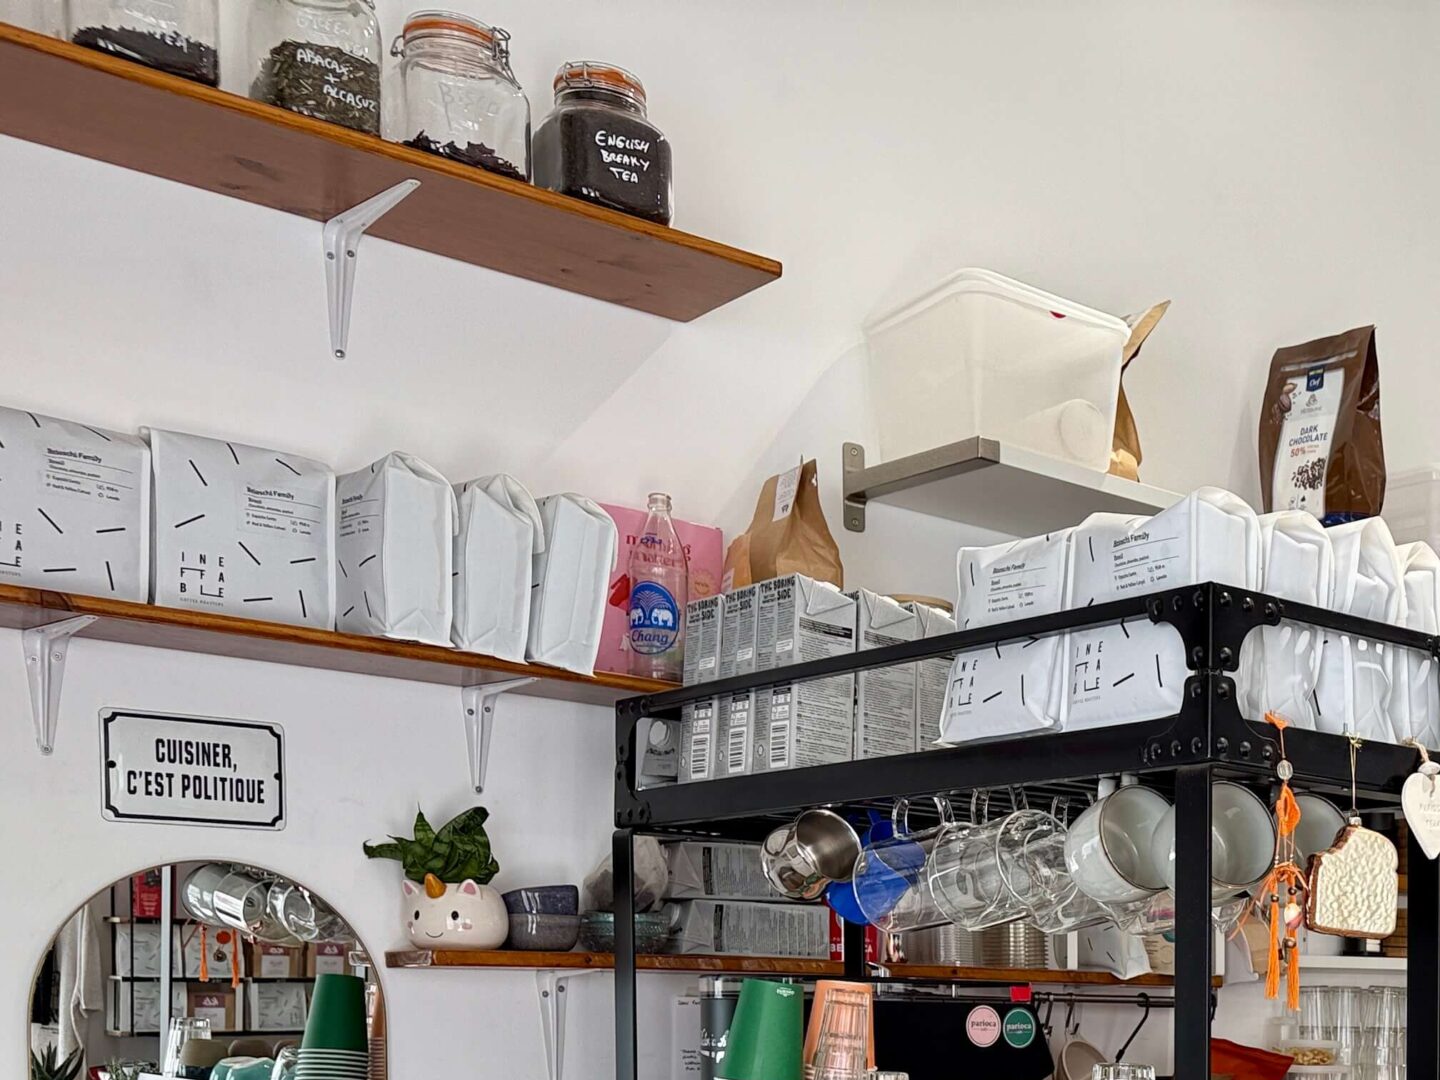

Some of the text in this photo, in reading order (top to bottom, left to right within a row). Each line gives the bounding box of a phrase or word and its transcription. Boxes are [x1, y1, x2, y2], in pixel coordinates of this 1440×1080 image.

[595, 130, 651, 154] ENGLISH
[609, 166, 640, 185] TEA
[1300, 424, 1319, 437] DARK
[1289, 432, 1328, 448] CHOCOLATE
[1290, 447, 1306, 458] 50%
[777, 588, 792, 601] SIDE
[631, 628, 670, 647] Chang
[155, 738, 237, 773] CUISINER,
[127, 770, 265, 804] C'EST POLITIQUE
[971, 1019, 997, 1030] parioca
[1006, 1021, 1032, 1032] parioca
